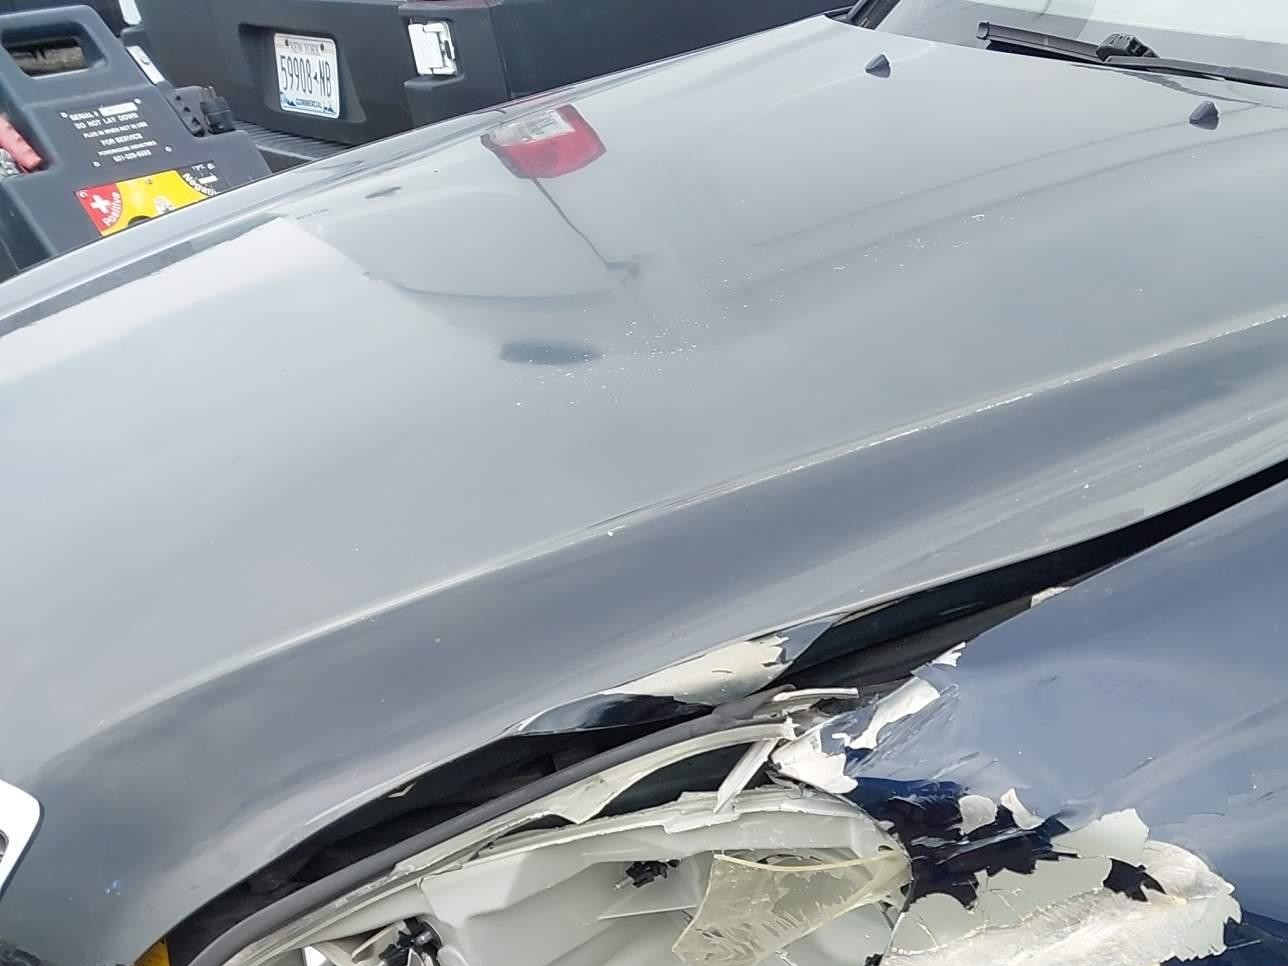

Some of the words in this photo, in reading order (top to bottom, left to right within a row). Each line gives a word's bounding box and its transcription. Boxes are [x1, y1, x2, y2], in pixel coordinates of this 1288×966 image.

[289, 41, 303, 54] NEW
[303, 43, 321, 56] YORK
[69, 112, 94, 121] SERIAL
[74, 122, 87, 130] DO
[87, 119, 101, 127] NOT
[102, 117, 116, 125] LAY
[117, 112, 139, 121] DOWN
[101, 138, 116, 146] FOR
[115, 132, 143, 144] SERVICE
[101, 190, 121, 228] Positive
